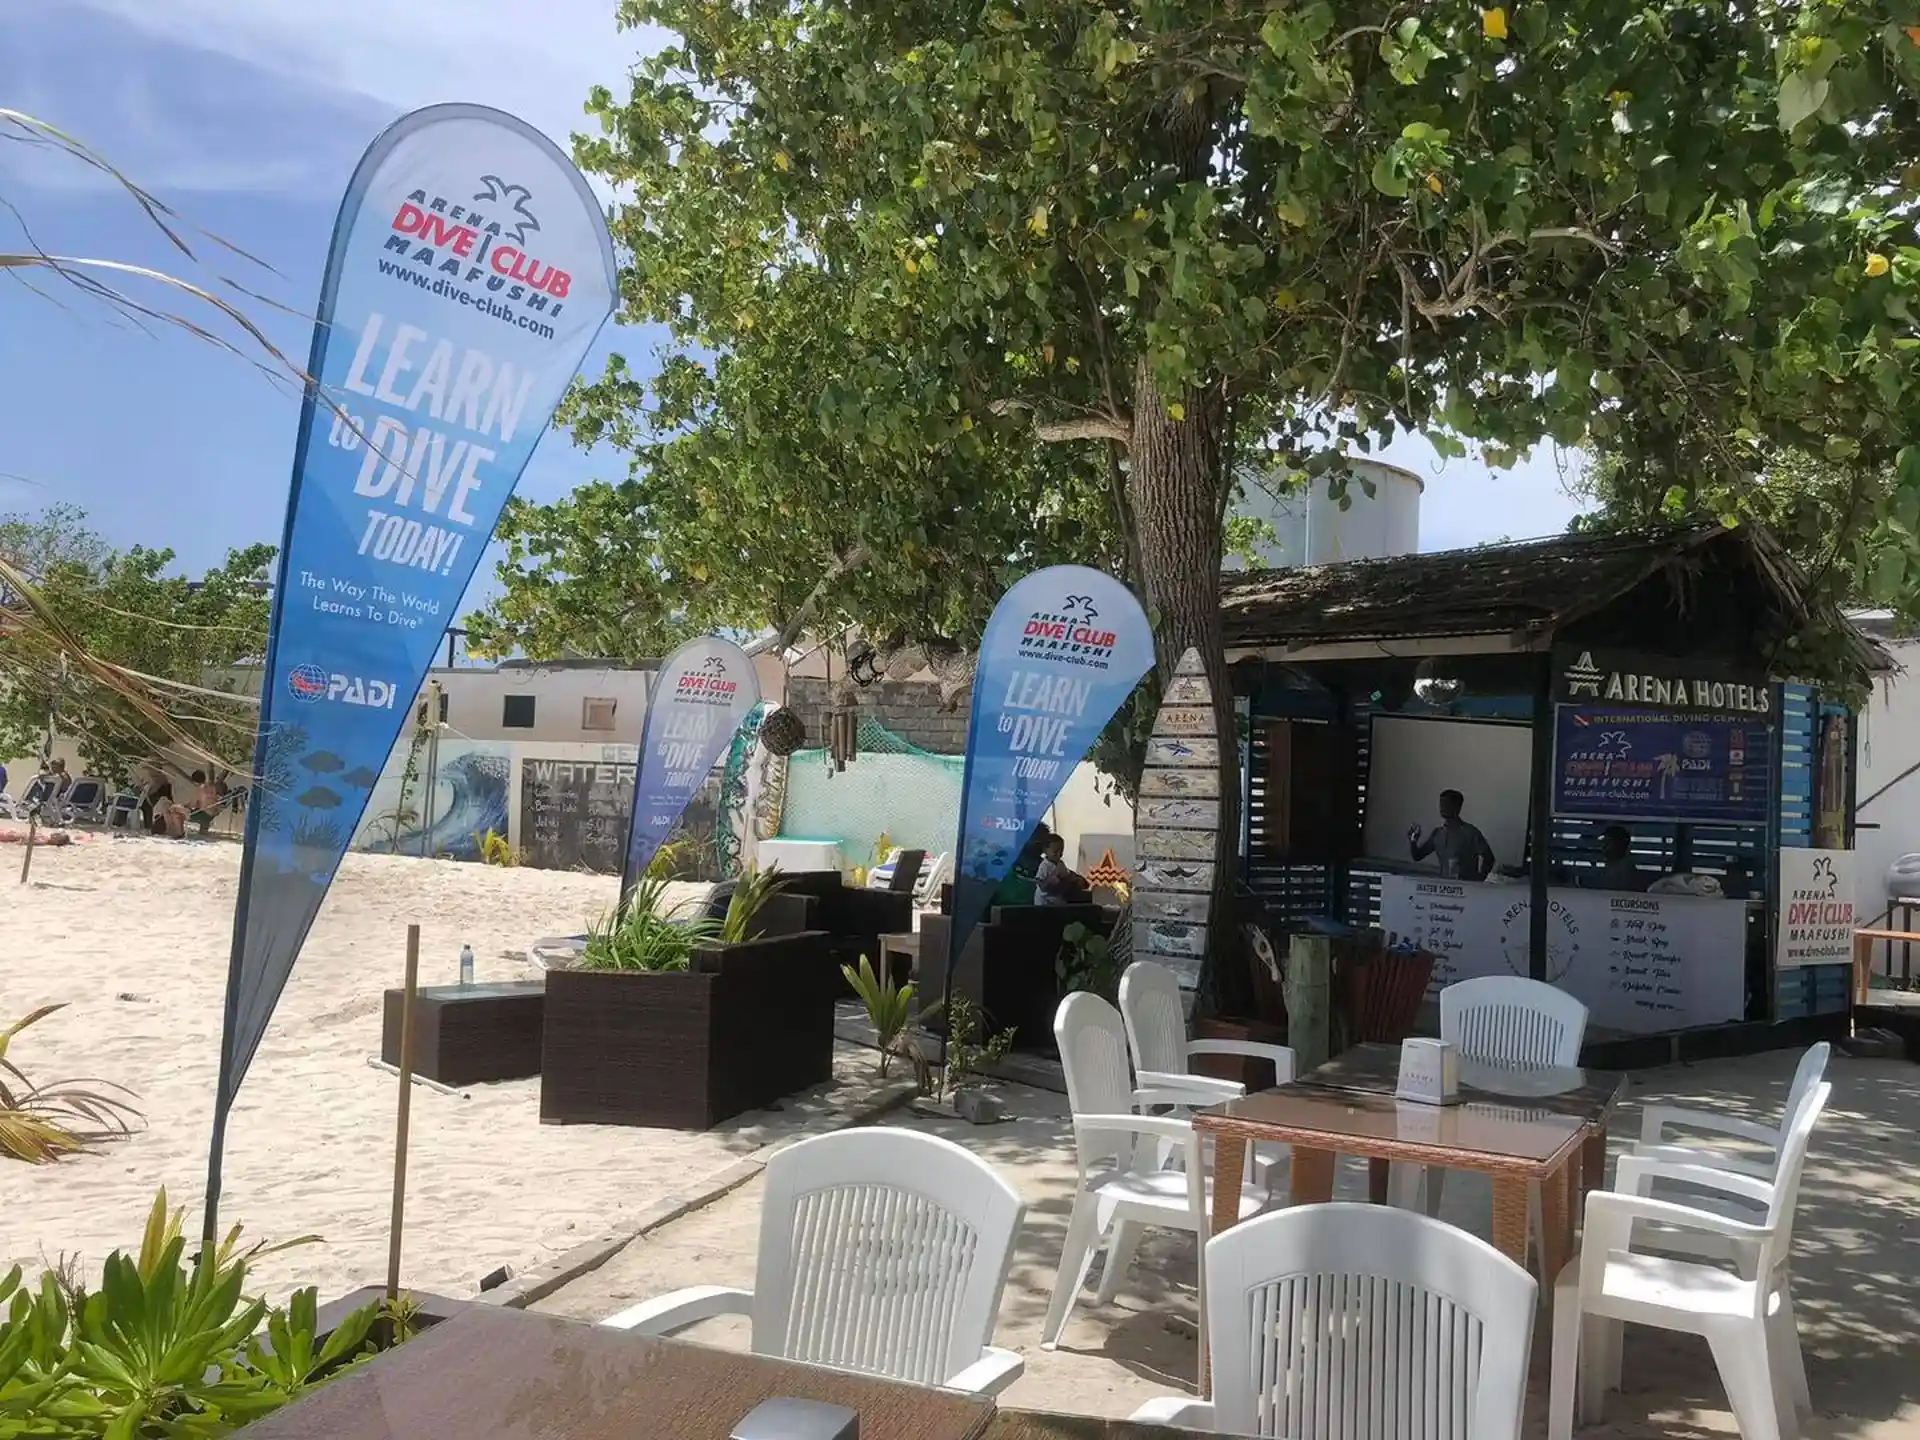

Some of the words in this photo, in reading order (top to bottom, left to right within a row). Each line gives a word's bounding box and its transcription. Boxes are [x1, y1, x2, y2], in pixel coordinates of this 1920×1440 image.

[407, 188, 501, 237] ARENA
[391, 201, 482, 259] DIVE
[490, 244, 572, 299] CLUB
[383, 233, 564, 319] MAAFUSHI
[378, 257, 556, 341] www.dive-club.com
[343, 312, 538, 443] LEARN
[327, 402, 365, 451] to
[353, 414, 496, 526] DIVE
[357, 509, 467, 577] TODAY!
[300, 571, 326, 591] The
[331, 577, 367, 601] Way
[371, 585, 397, 605] The
[401, 592, 440, 616] World
[313, 596, 363, 619] Learns
[366, 605, 384, 623] To
[1031, 612, 1078, 625] ARENA
[1020, 636, 1113, 659] MAAFUSHI
[1023, 620, 1065, 640] DIVE
[1072, 626, 1117, 647] CLUB
[1018, 649, 1109, 670] www.dive-club.com
[327, 674, 397, 709] PADI
[678, 676, 703, 689] DIVE
[709, 679, 737, 693] CLUB
[1004, 671, 1091, 717] LEARN
[1604, 671, 1690, 706] ARENA
[1692, 679, 1770, 713] HOTELS
[997, 711, 1012, 734] to
[1009, 714, 1074, 757] DIVE
[664, 742, 704, 769] DIVE
[1011, 756, 1058, 781] TODAY!
[535, 761, 637, 785] WATER
[995, 817, 1025, 832] PADI
[1792, 889, 1826, 901] ARENA
[1502, 899, 1533, 929] AREN
[1788, 903, 1818, 925] DIVE
[1824, 903, 1853, 925] CLUB
[1789, 927, 1850, 942] MAAFUSHI
